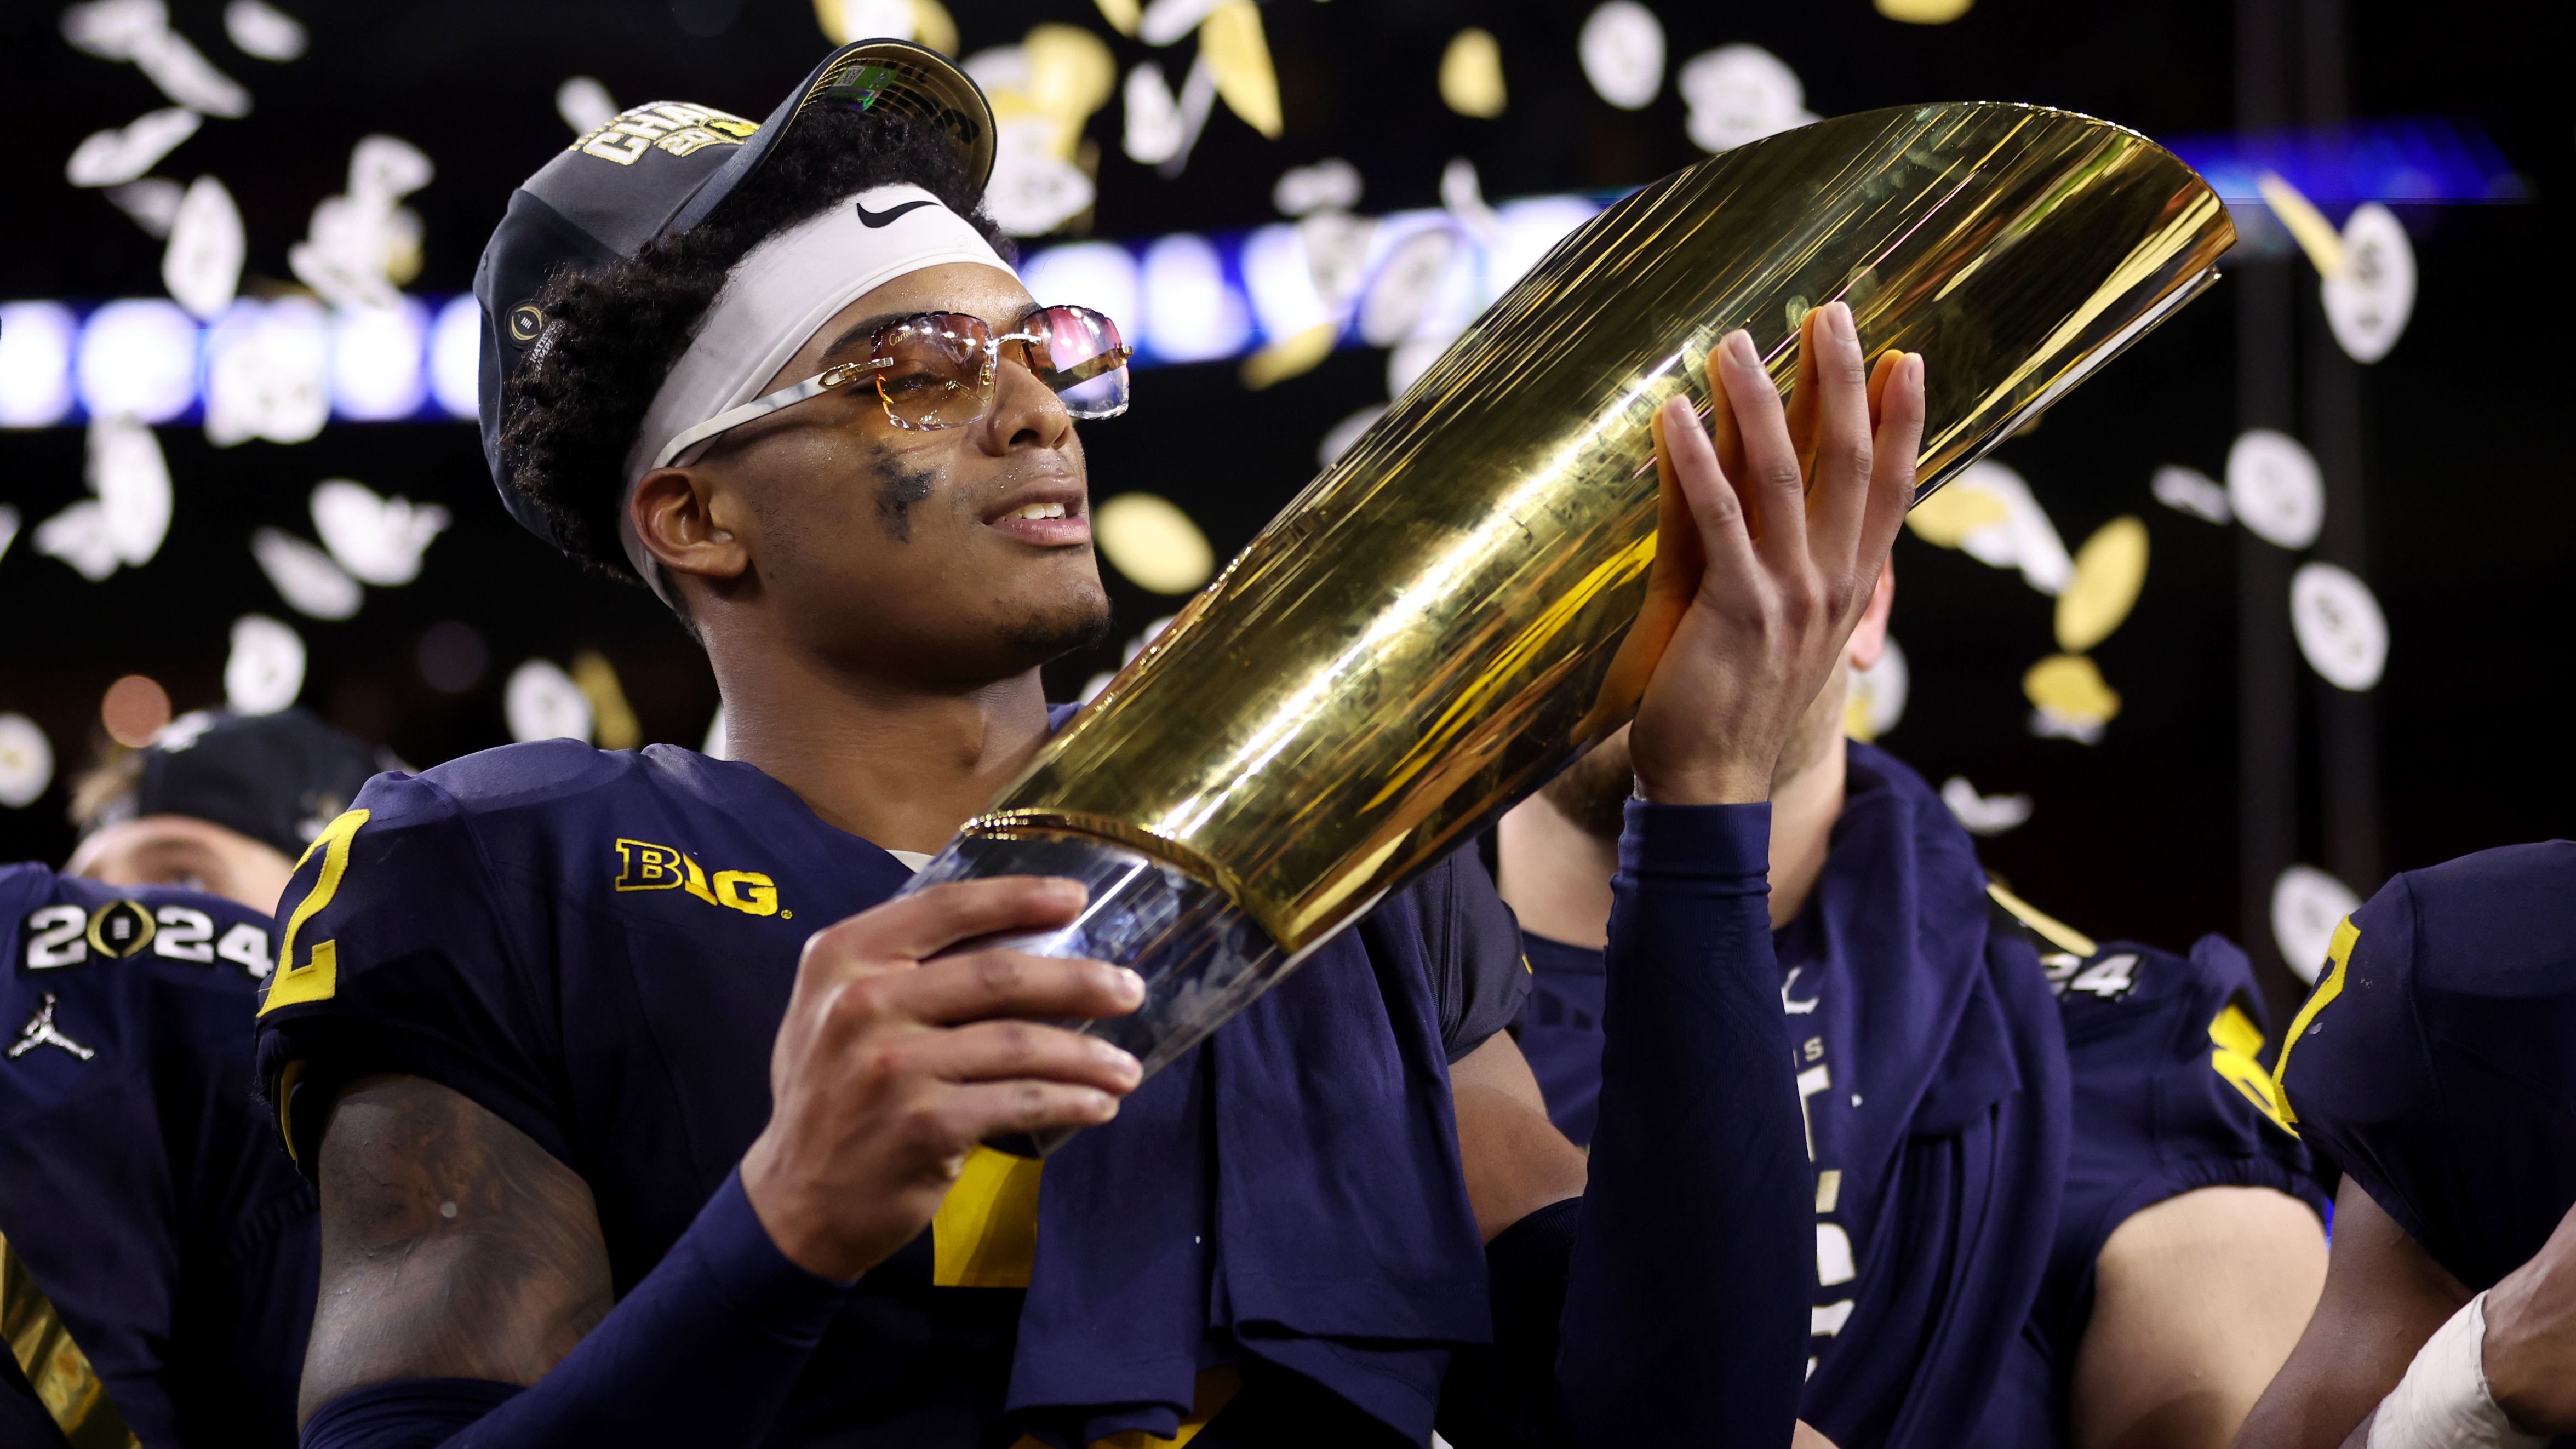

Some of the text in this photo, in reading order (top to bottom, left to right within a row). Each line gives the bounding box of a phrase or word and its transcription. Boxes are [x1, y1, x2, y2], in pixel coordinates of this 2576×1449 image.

[582, 102, 710, 165] CHA
[889, 327, 915, 346] Cartier
[27, 900, 274, 978] 2024
[256, 809, 371, 1018] 2
